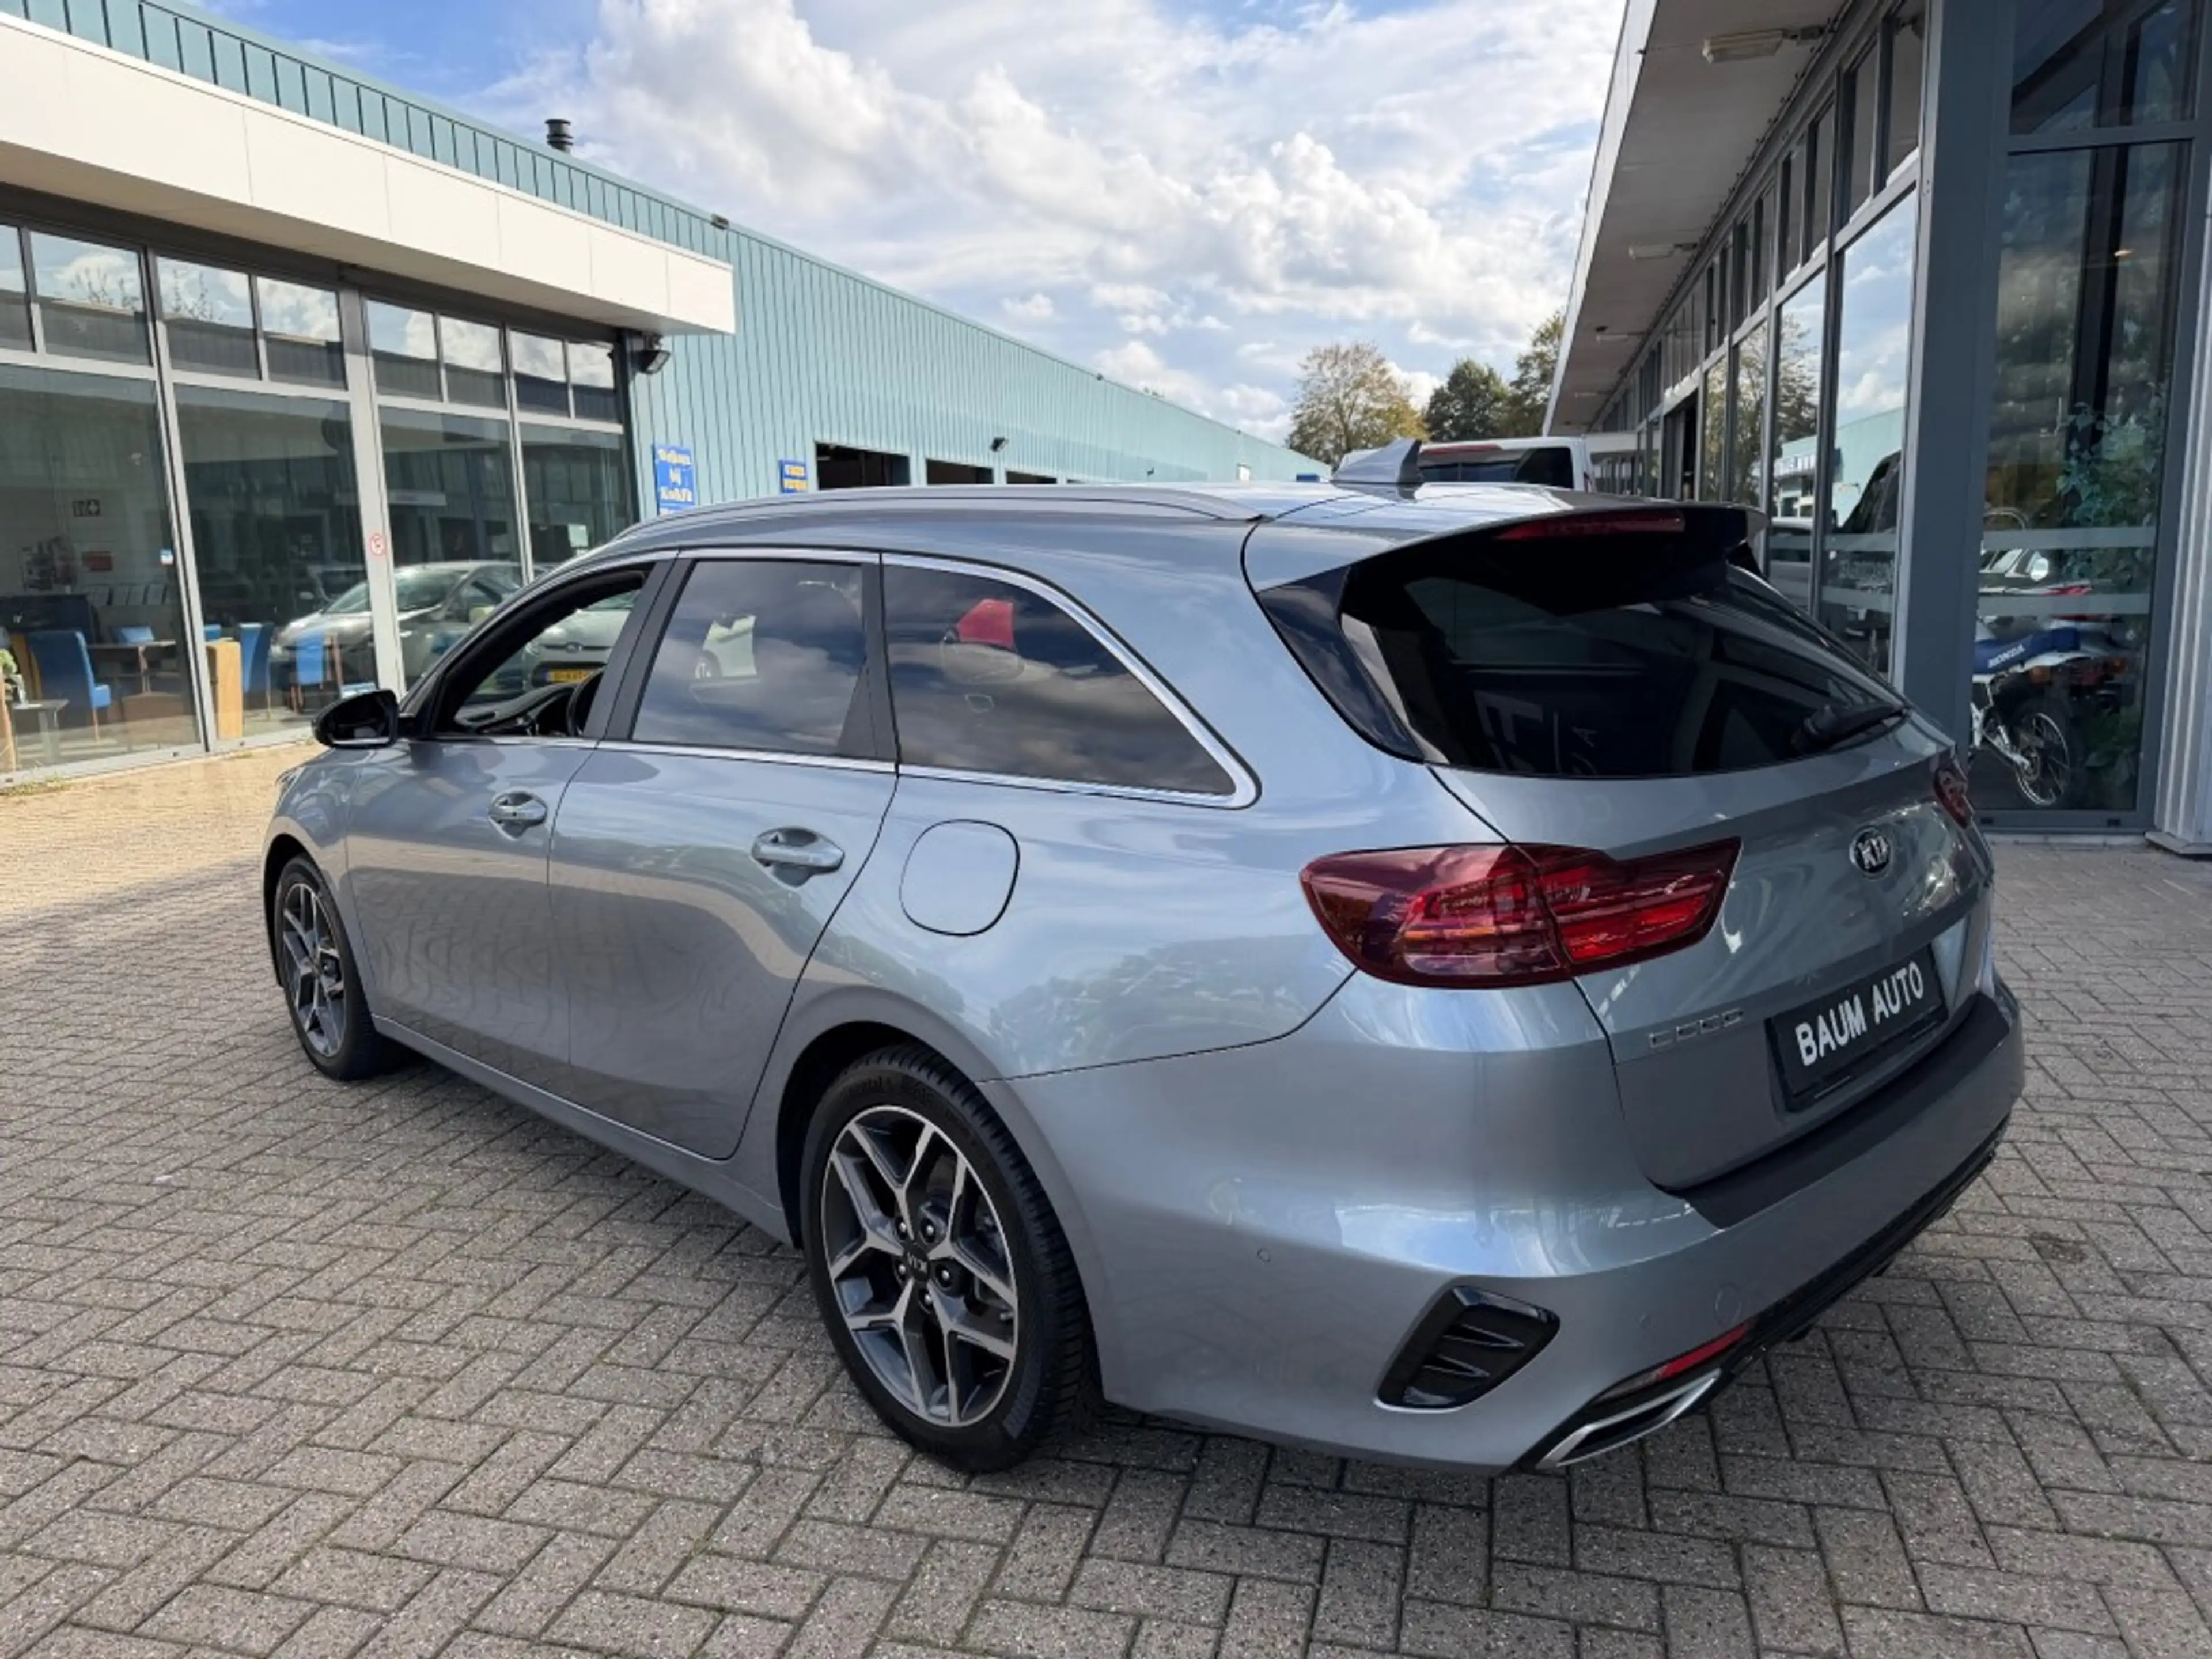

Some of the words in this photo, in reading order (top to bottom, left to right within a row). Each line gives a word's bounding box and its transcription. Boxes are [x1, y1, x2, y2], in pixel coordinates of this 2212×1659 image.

[1858, 835, 1889, 869] KIA
[1795, 994, 1867, 1066] BAUM
[1873, 961, 1923, 1025] AUTO
